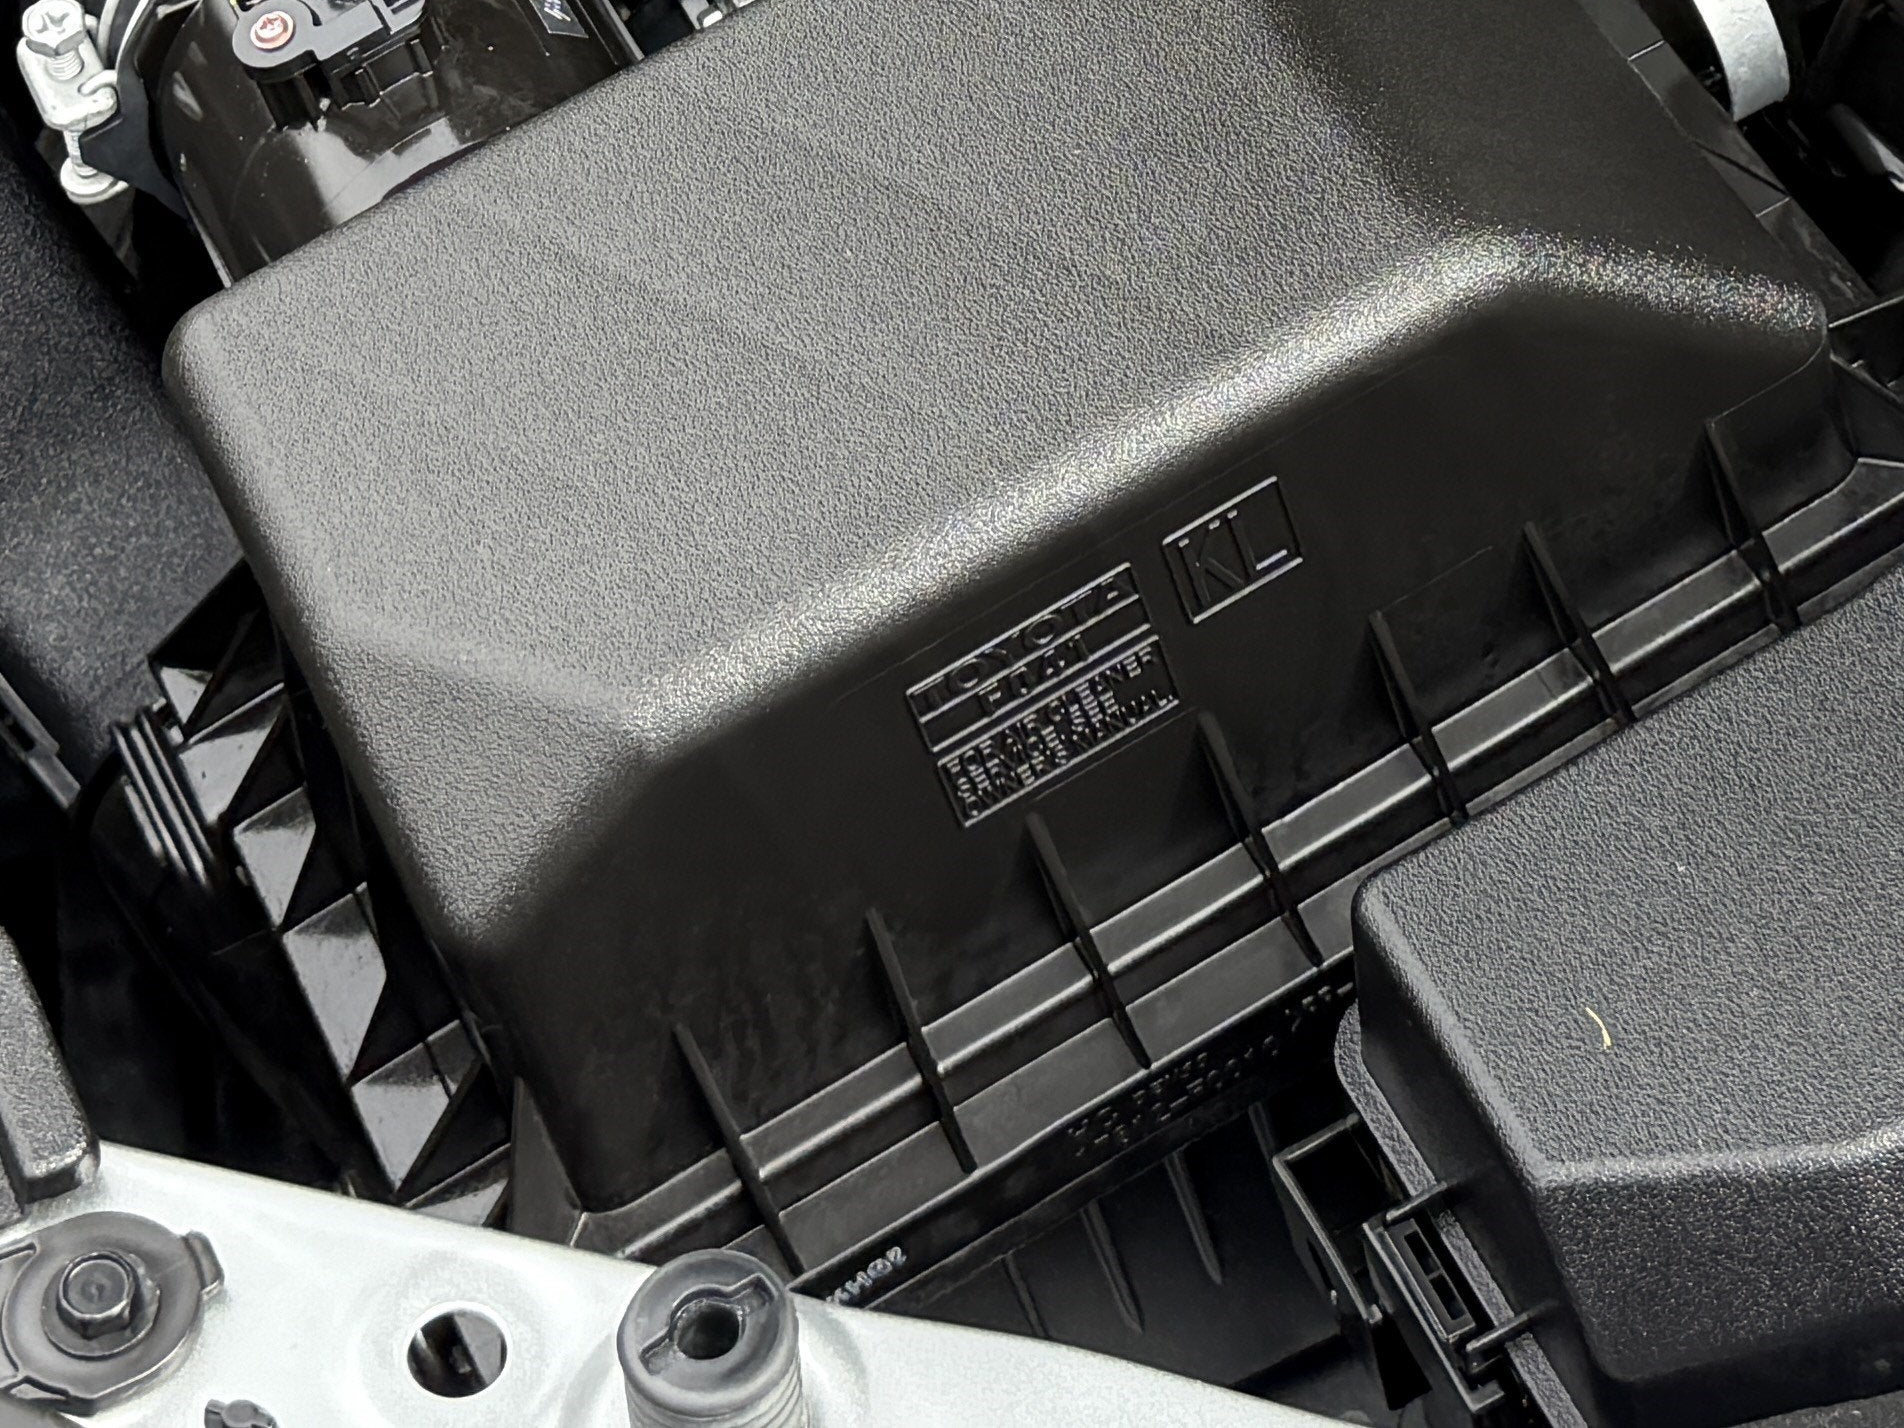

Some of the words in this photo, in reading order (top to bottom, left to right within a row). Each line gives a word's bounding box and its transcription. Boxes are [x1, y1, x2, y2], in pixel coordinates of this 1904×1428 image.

[1177, 508, 1289, 604] KL
[917, 575, 1135, 708] TOYOTA
[946, 740, 1001, 778] FOR
[1002, 714, 1043, 744] AIR
[1045, 646, 1159, 721] CLEANER
[1069, 692, 1120, 731] SEE
[963, 746, 1071, 817] OWNER'S
